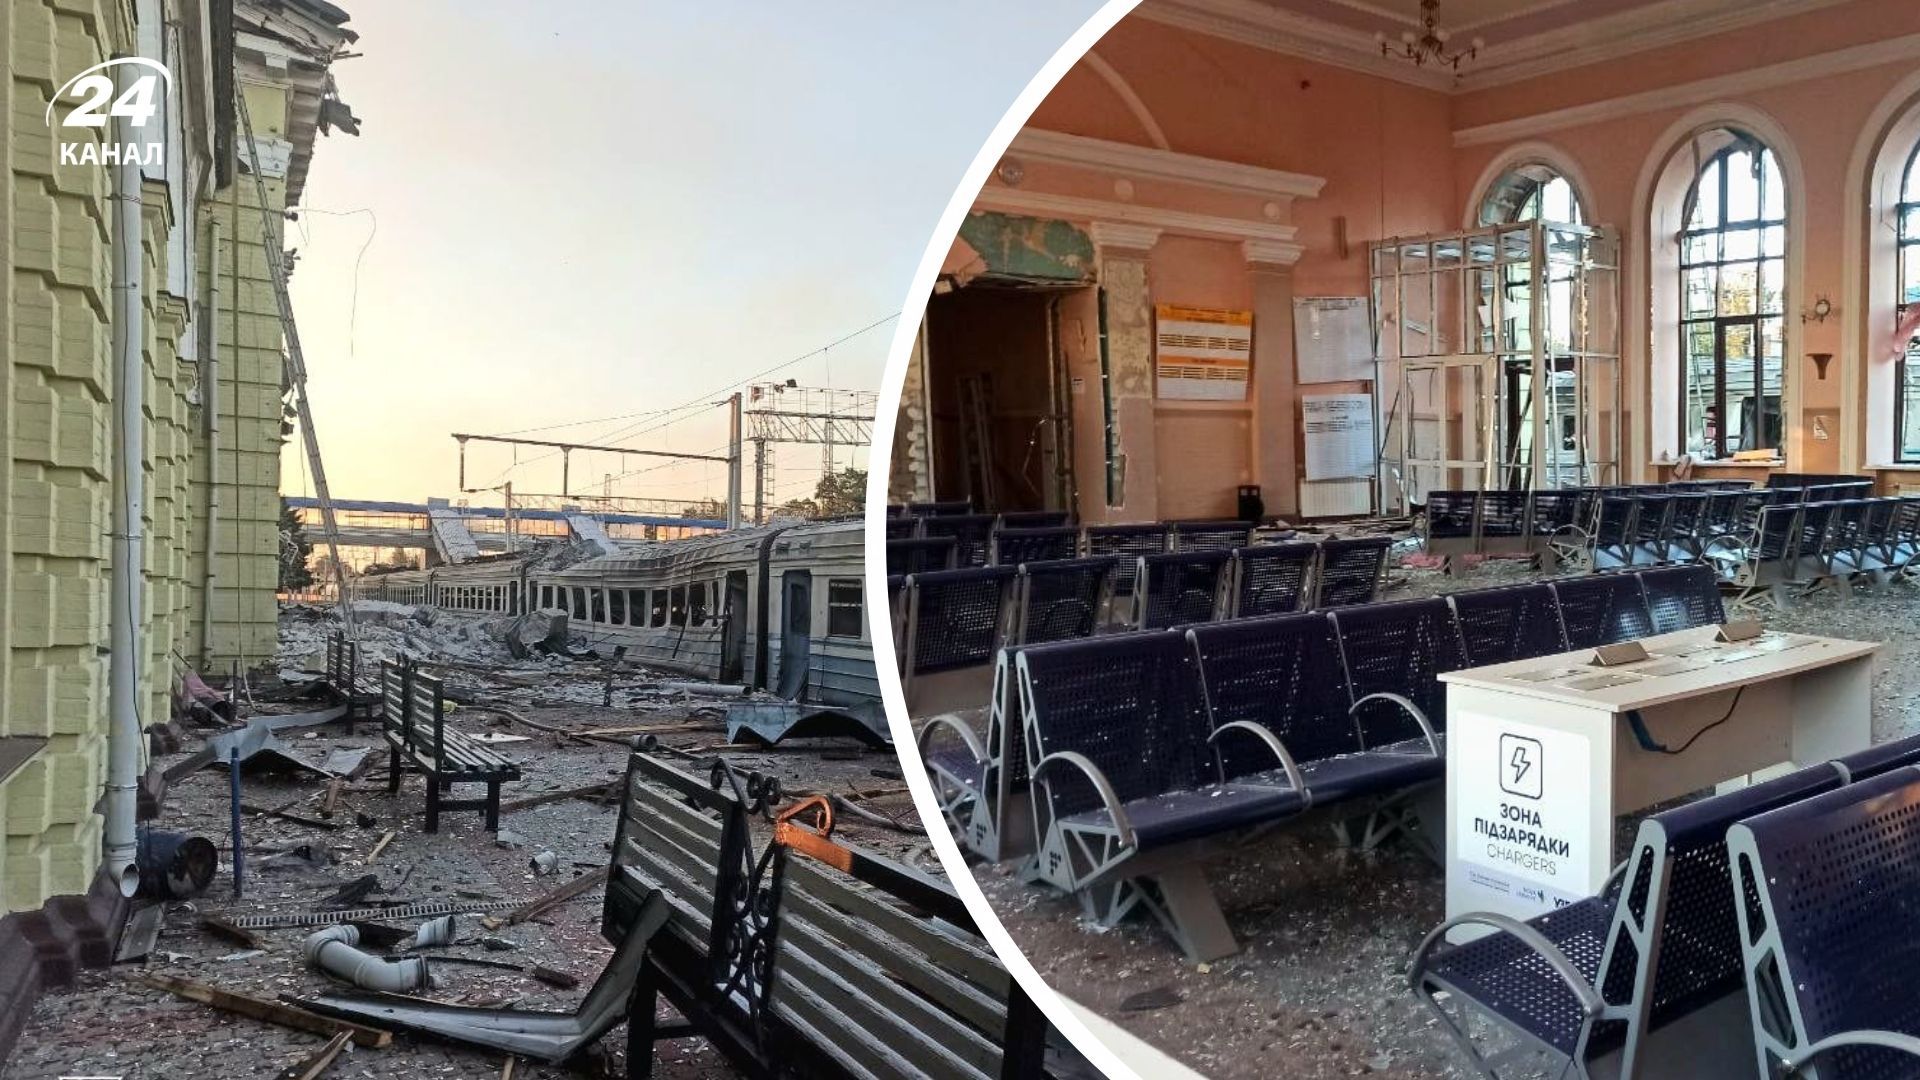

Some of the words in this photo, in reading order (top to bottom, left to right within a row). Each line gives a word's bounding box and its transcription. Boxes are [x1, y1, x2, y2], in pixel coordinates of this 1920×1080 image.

[1500, 803, 1543, 828] ЗОНА
[1475, 817, 1569, 858] ПІДЗАРЯДКИ
[1487, 843, 1556, 876] CHARGERS
